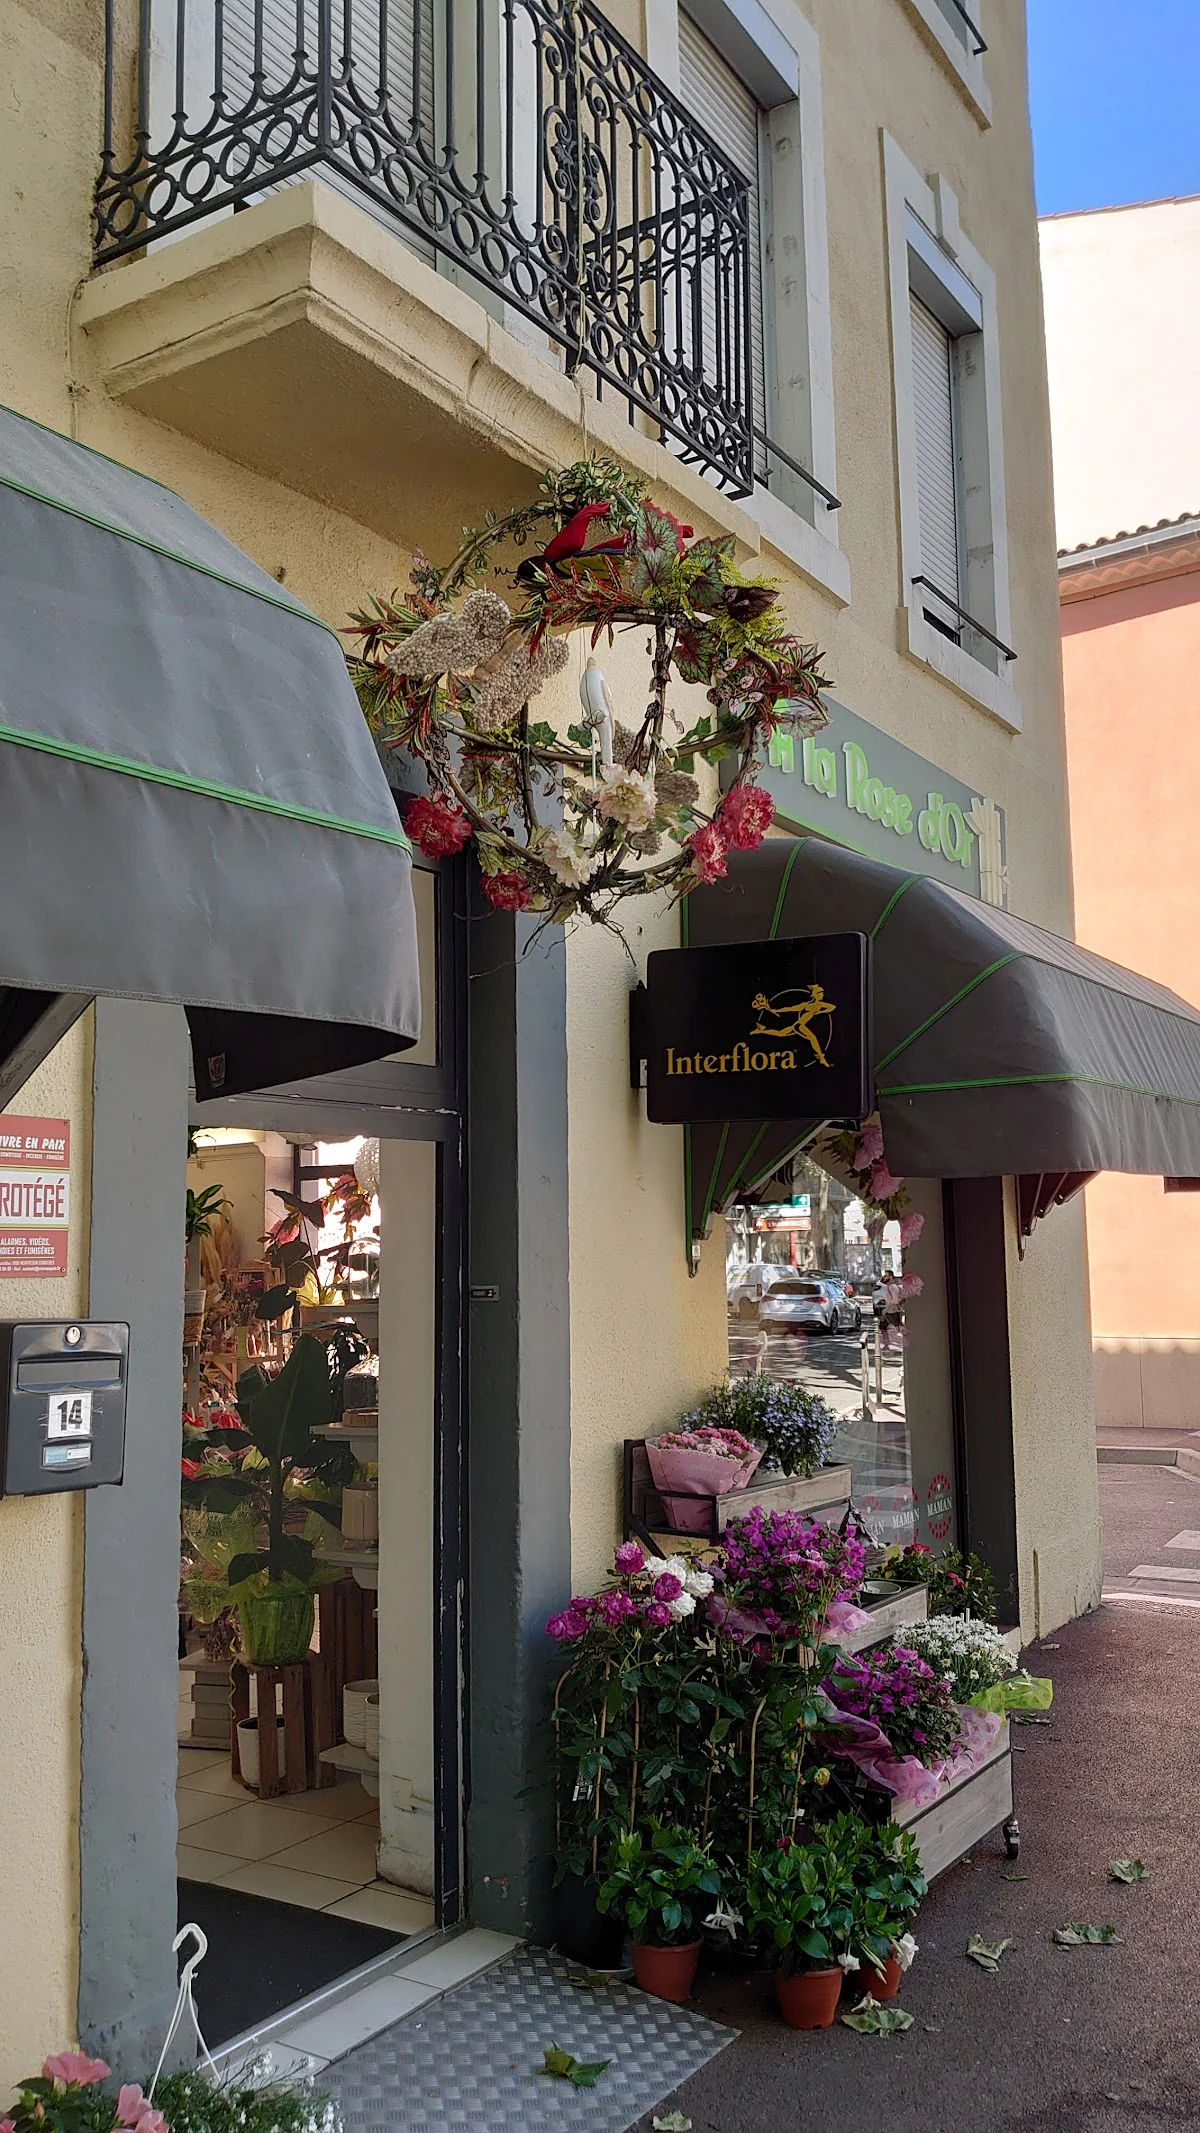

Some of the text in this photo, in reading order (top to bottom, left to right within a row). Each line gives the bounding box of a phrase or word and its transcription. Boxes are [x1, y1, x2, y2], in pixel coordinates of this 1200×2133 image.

[803, 736, 837, 798] la
[842, 741, 914, 836] Rose
[665, 1041, 797, 1076] Interflora
[25, 1136, 39, 1149] EN
[42, 1138, 66, 1151] PAIX
[16, 1247, 23, 1255] ET
[57, 1399, 83, 1431] 14
[927, 1497, 953, 1518] MAMAN
[892, 1508, 920, 1530] MAMAN
